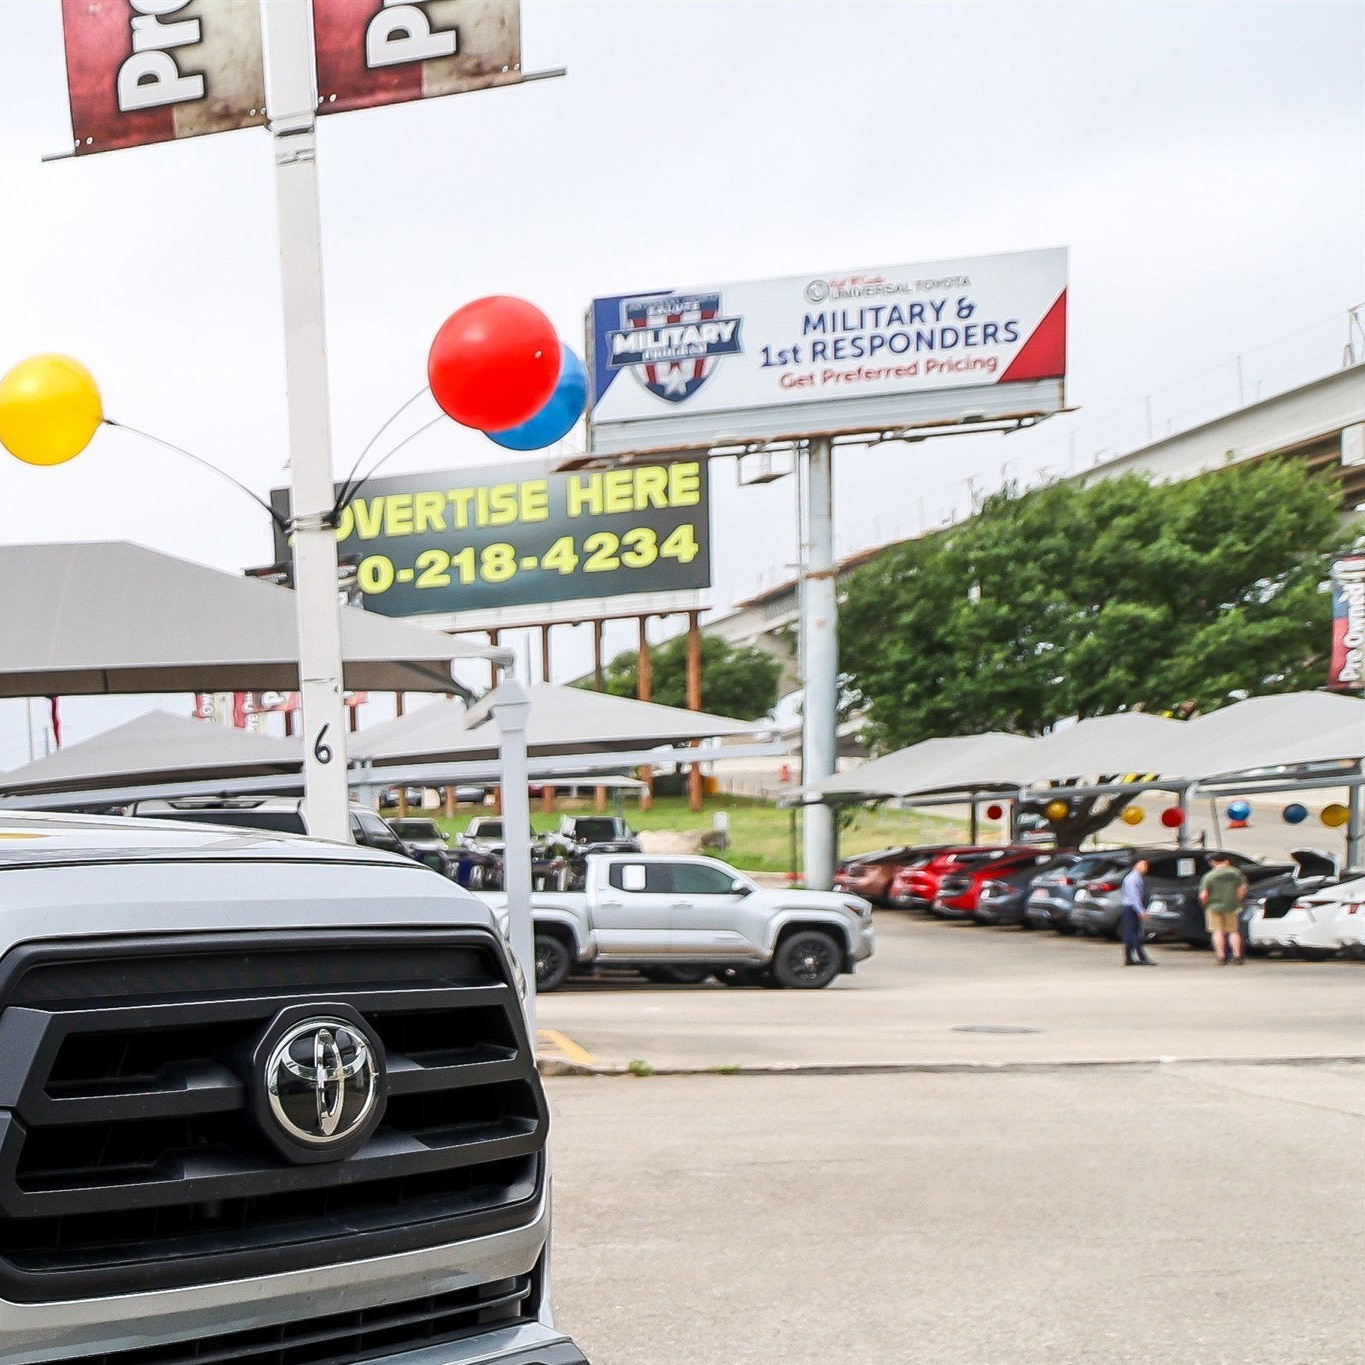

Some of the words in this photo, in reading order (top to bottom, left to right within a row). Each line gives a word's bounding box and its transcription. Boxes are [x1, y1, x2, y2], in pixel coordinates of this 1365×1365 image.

[612, 320, 737, 355] MILITARY
[803, 298, 948, 336] MILITARY
[957, 297, 976, 320] &
[760, 344, 801, 369] 1st
[814, 320, 1021, 363] RESPONDERS
[778, 370, 816, 391] Get
[821, 359, 920, 386] Preferred
[925, 352, 1000, 380] Pricing
[335, 479, 550, 542] DVERTISE
[566, 461, 701, 517] HERE
[357, 523, 700, 594] 0-218-4234
[314, 722, 333, 765] 6
